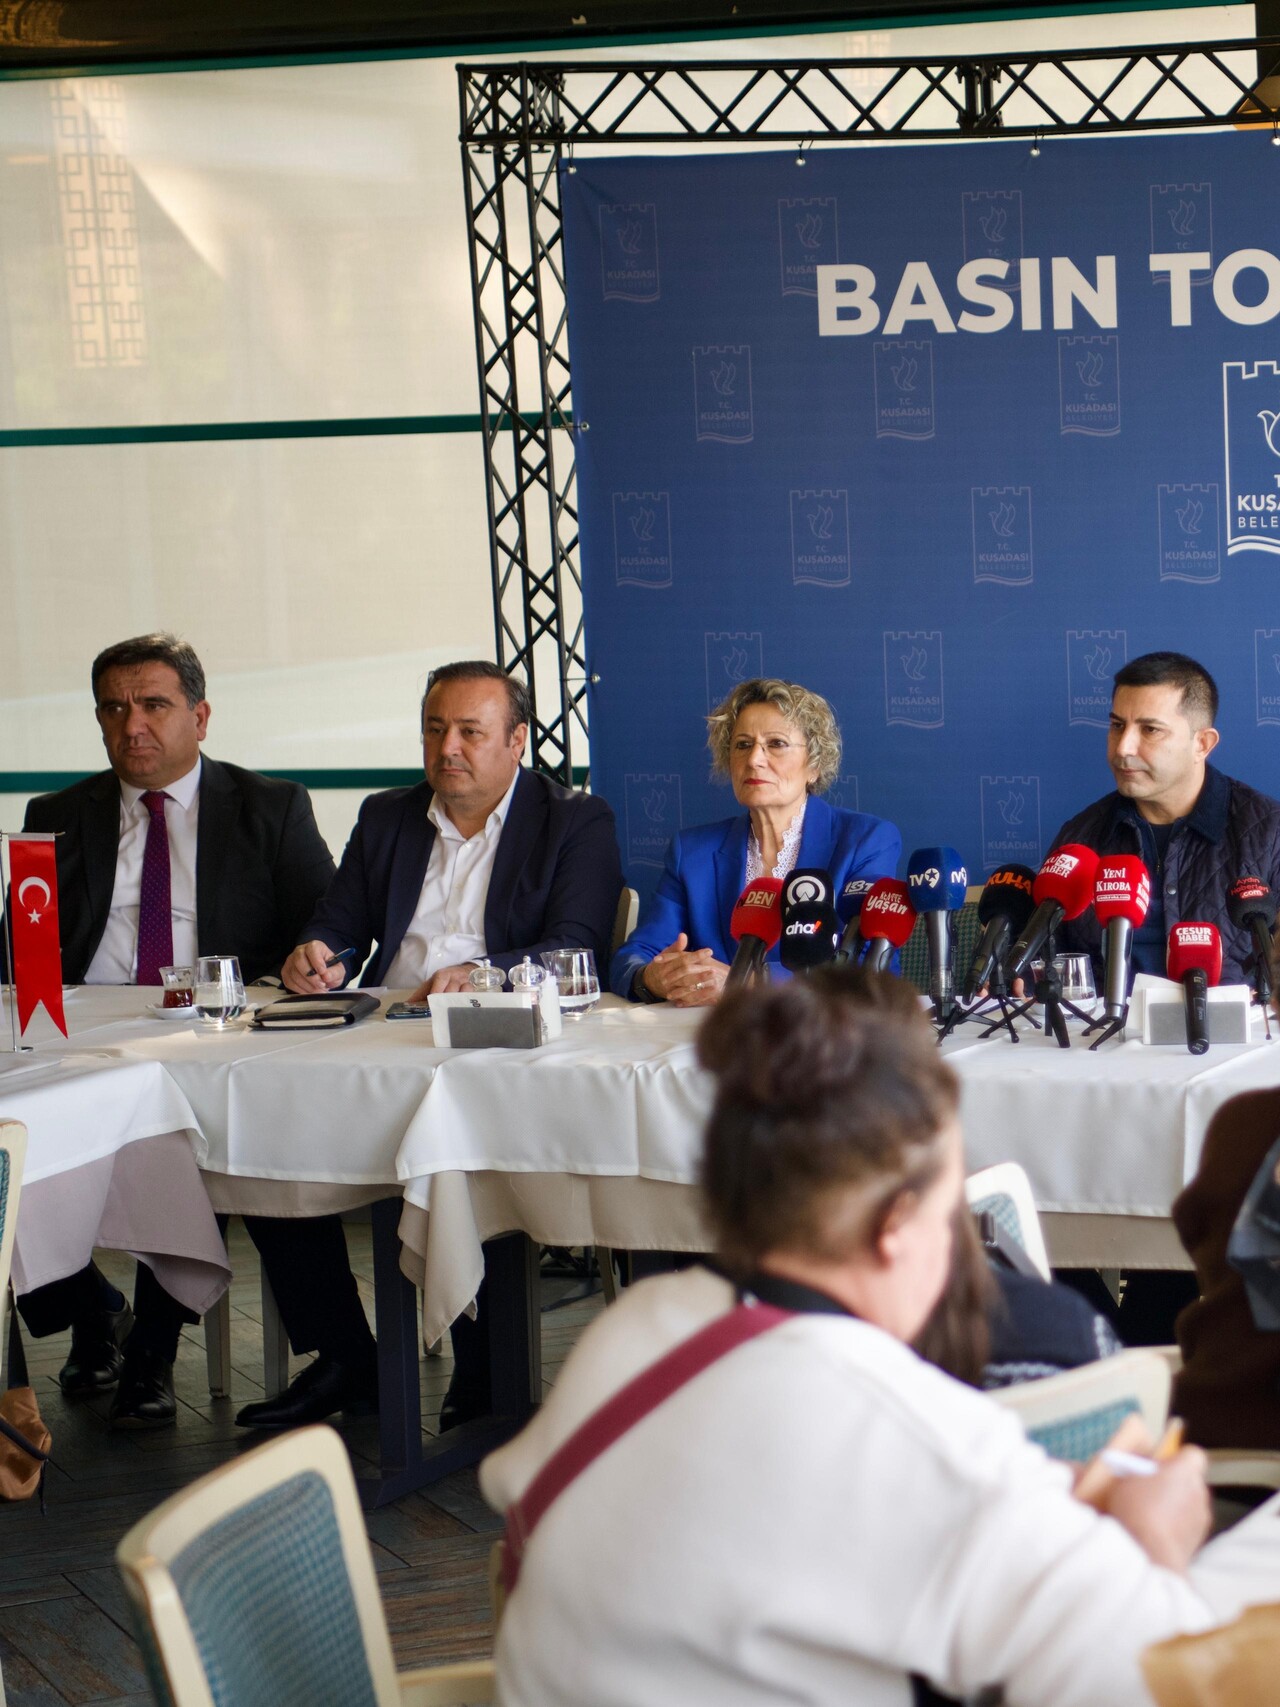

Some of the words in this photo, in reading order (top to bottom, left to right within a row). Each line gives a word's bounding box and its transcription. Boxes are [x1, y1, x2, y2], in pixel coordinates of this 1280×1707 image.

[817, 255, 1118, 337] BASIN
[909, 867, 940, 889] TV9
[1096, 880, 1131, 892] KIROBA
[1175, 927, 1212, 936] CESUR
[1178, 934, 1212, 943] HABER
